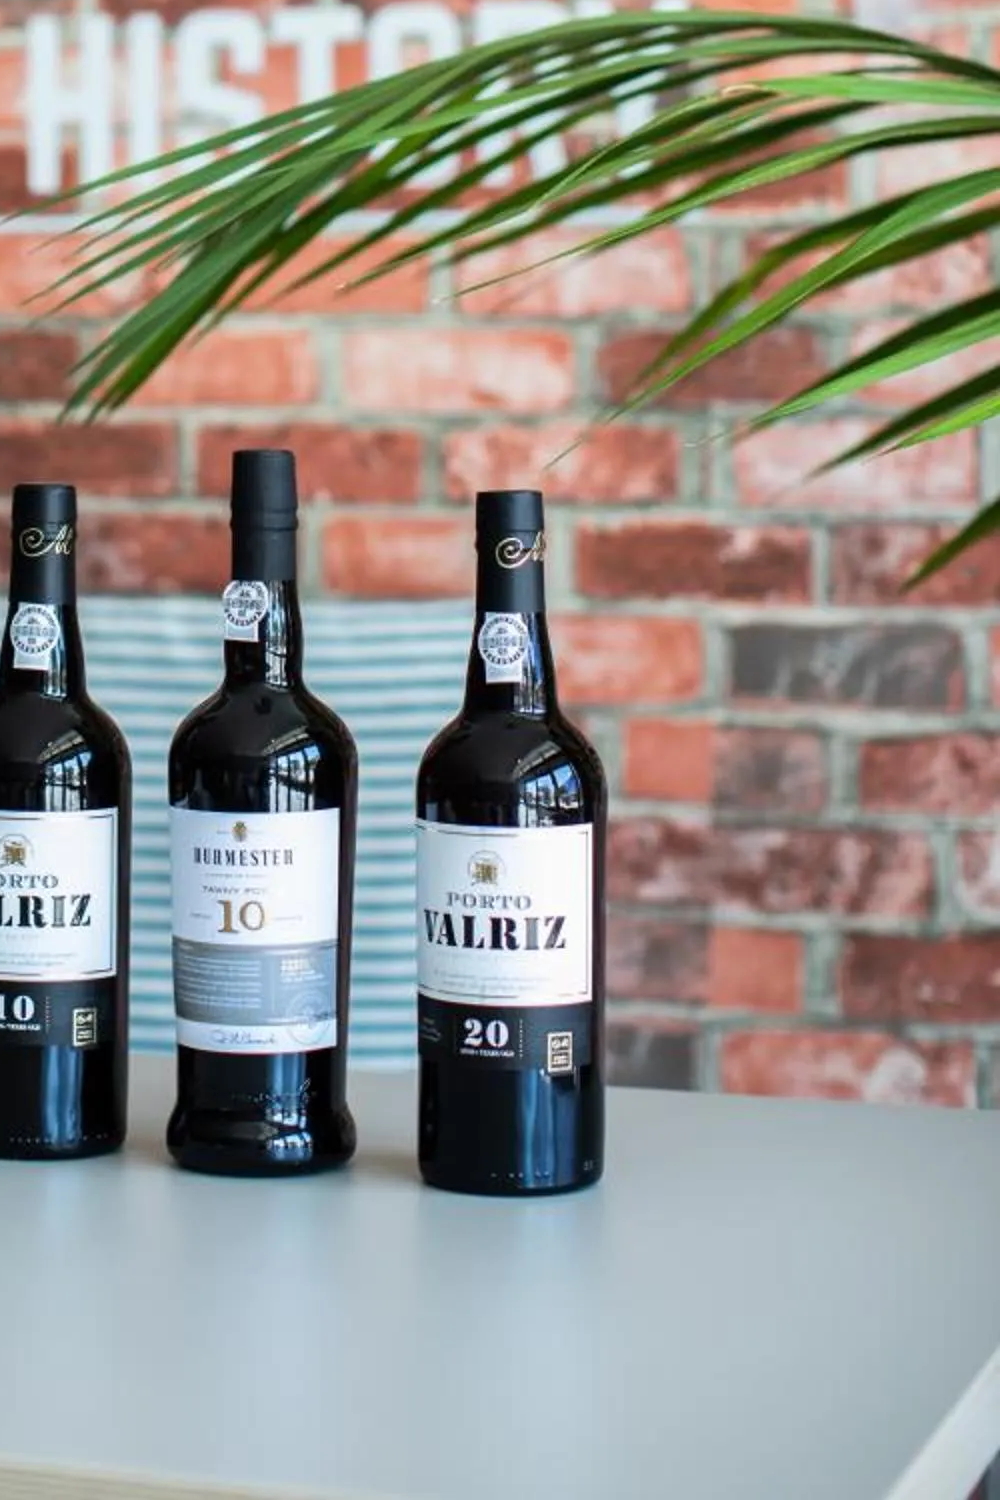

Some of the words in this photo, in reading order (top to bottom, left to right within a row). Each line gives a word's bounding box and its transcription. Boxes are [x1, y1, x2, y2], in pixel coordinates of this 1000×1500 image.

[216, 899, 266, 934] 10
[446, 891, 532, 911] PORTO
[423, 908, 567, 951] VALRIZ
[463, 1017, 509, 1048] 20
